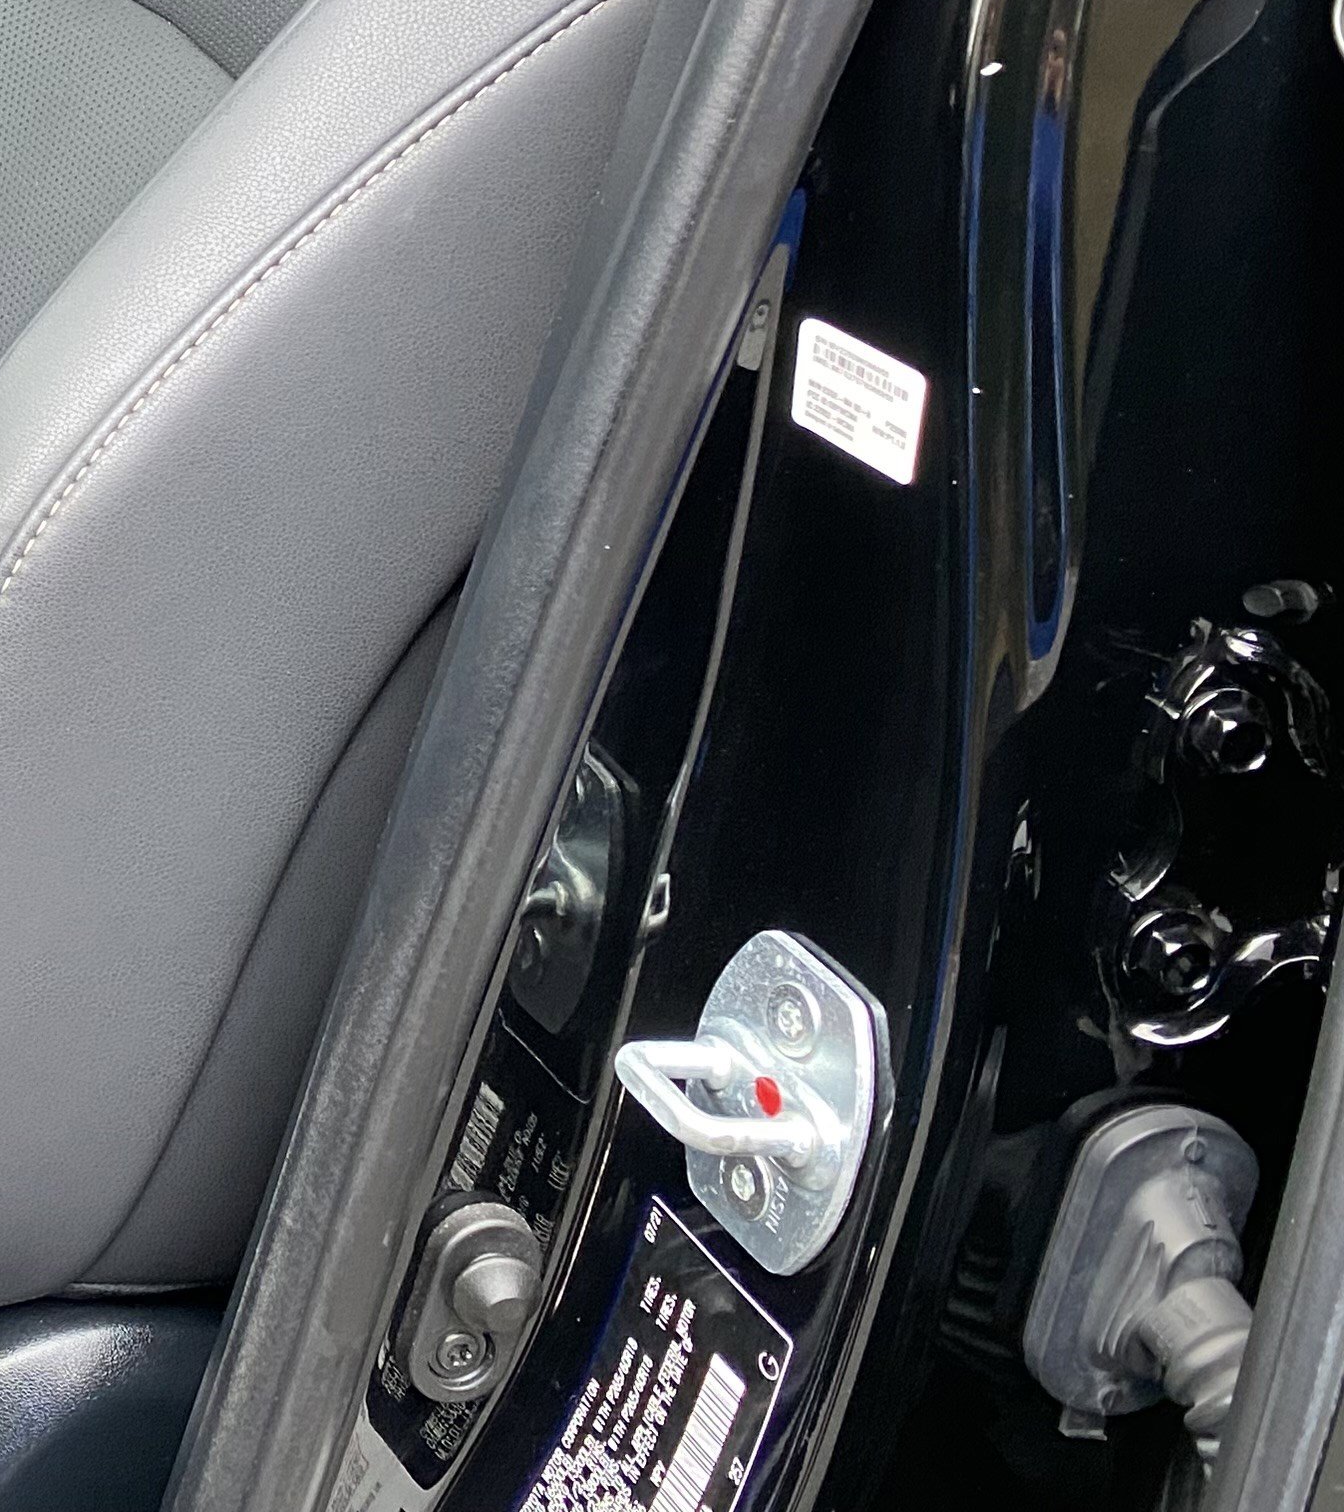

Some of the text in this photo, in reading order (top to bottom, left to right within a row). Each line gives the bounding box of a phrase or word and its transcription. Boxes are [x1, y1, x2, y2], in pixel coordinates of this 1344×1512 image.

[764, 1175, 789, 1235] AISIN
[643, 1206, 662, 1244] 07/21
[757, 1351, 780, 1381] G
